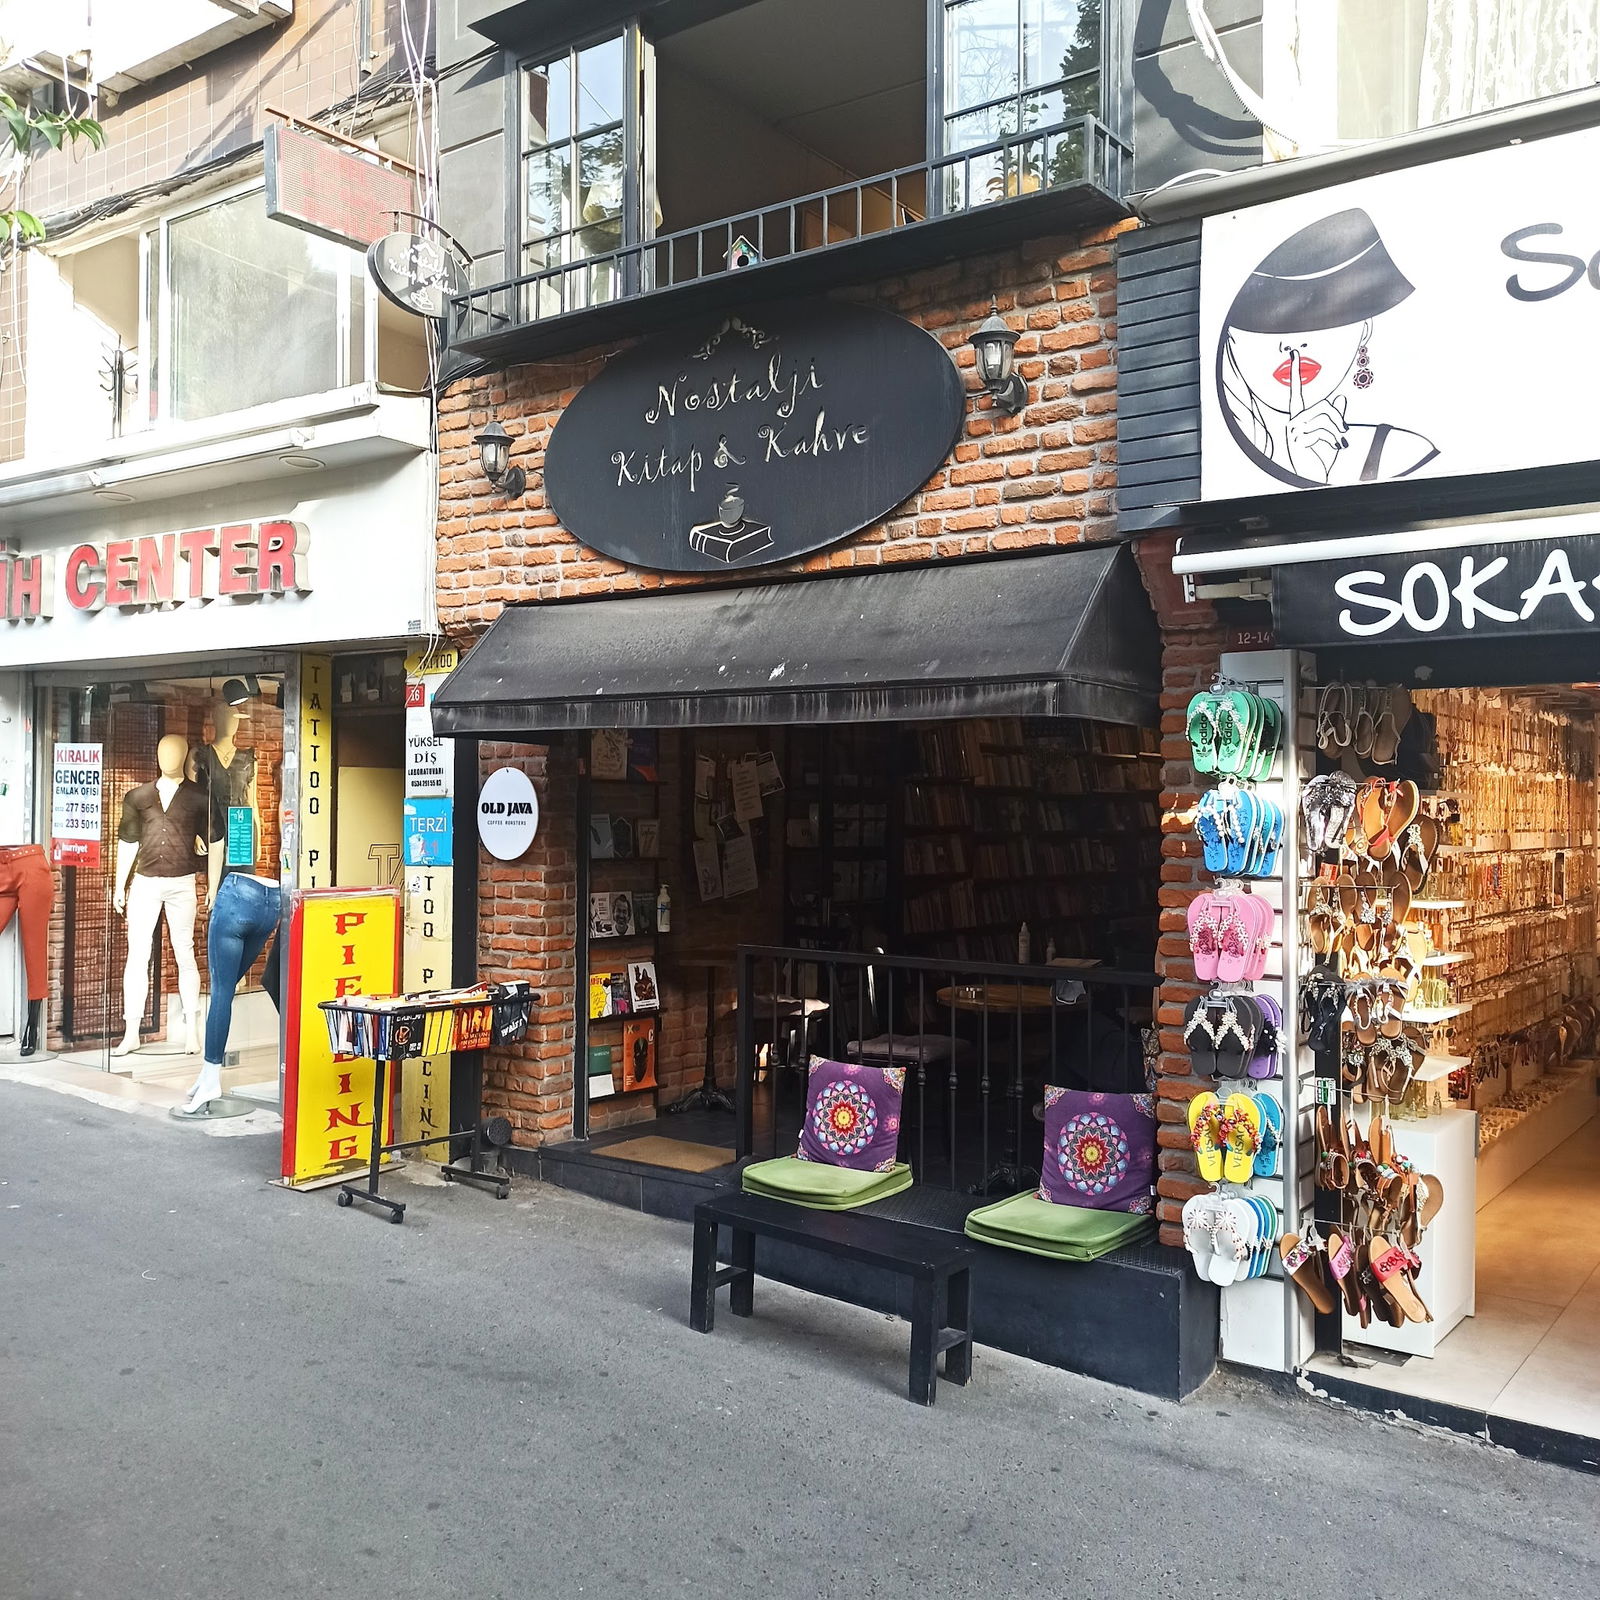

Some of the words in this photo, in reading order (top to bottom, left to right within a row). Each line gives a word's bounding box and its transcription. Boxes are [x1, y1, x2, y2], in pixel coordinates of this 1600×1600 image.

[1500, 222, 1600, 302] S
[645, 353, 825, 424] Nostalji
[611, 444, 702, 492] Kitap
[713, 433, 746, 468] &
[758, 406, 870, 462] Kahve
[65, 519, 311, 612] CENTER
[1333, 548, 1600, 637] SOKA
[309, 666, 321, 815] TATTOO
[408, 735, 443, 748] YÜKSEL
[1200, 712, 1208, 745] adida
[1223, 711, 1233, 745] adida
[56, 748, 100, 763] KİRALIK
[414, 751, 437, 765] DİŞ
[55, 770, 100, 785] GENCER
[56, 787, 79, 796] EMLAK
[65, 803, 79, 813] 277
[80, 804, 99, 813] 5651
[65, 819, 79, 829] 233
[80, 820, 98, 830] 5011
[410, 812, 447, 832] TERZİ
[481, 802, 505, 814] OLD
[507, 802, 533, 817] JAVA
[324, 912, 373, 1160] PIEING
[1204, 1128, 1216, 1167] VERSAC
[1232, 1128, 1245, 1168] VERSAC
